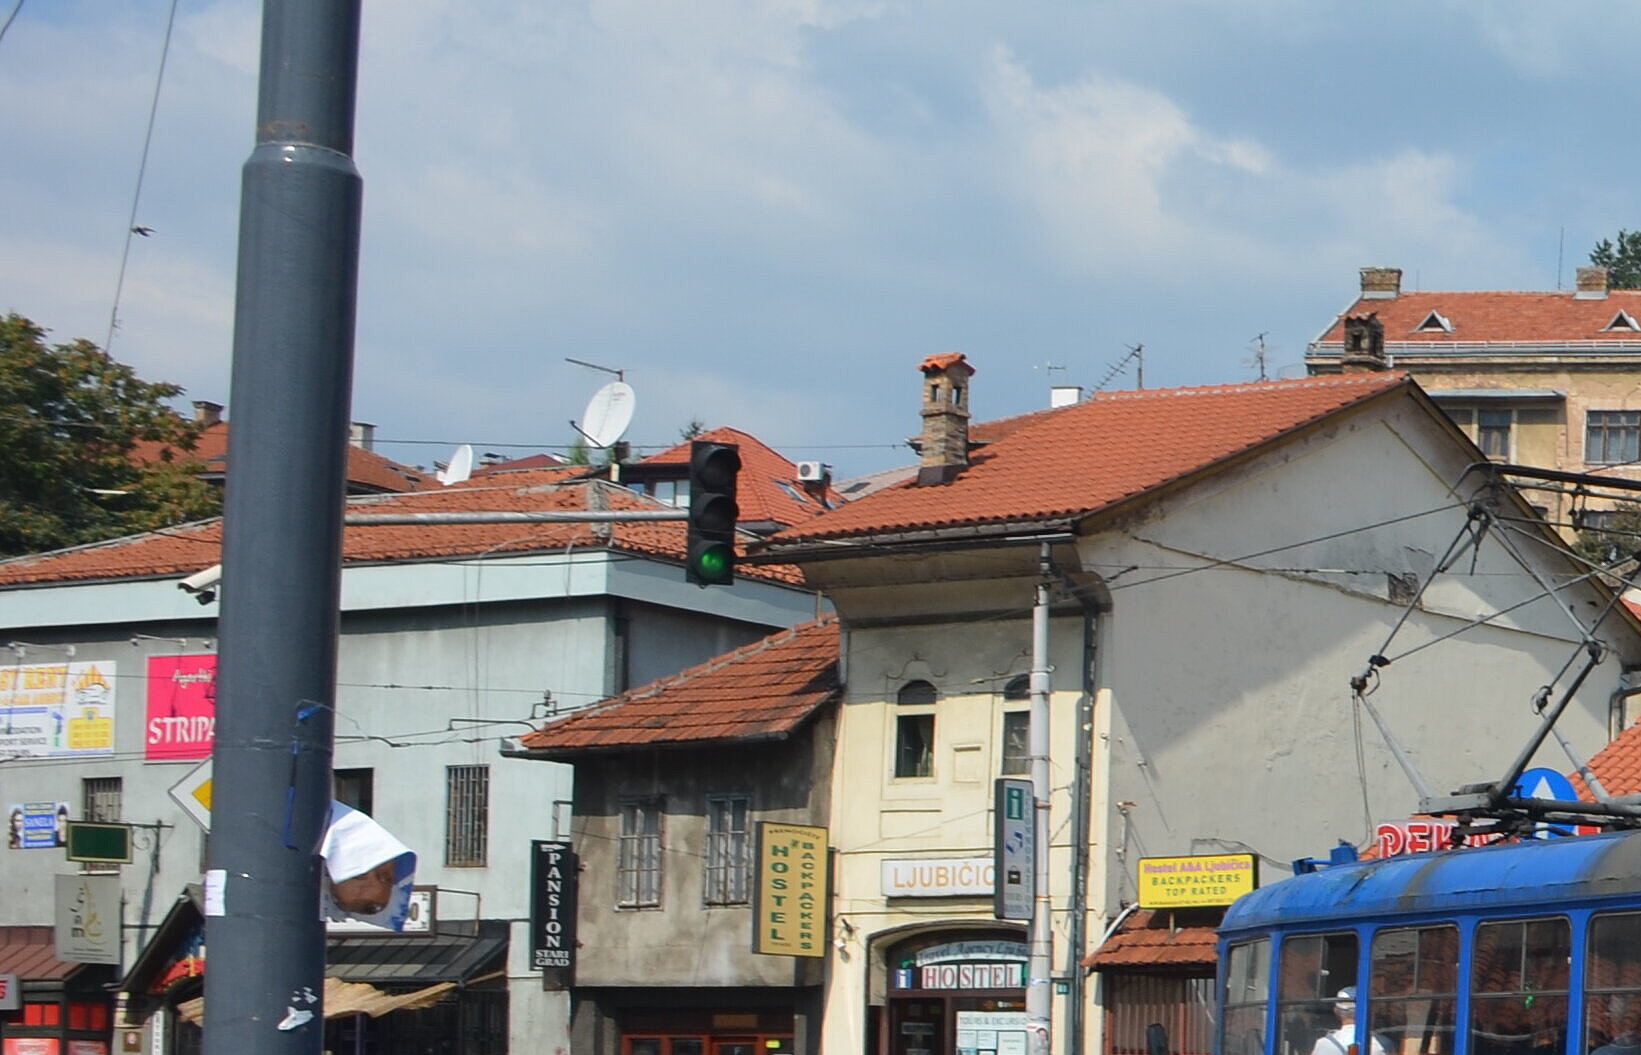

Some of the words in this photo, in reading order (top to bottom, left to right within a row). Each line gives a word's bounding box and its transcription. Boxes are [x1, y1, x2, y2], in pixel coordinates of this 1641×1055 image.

[1152, 874, 1241, 886] BACKPACKERS
[770, 844, 789, 941] HOSTEL
[799, 842, 815, 950] BACKPACKERS
[1166, 888, 1187, 897] TOP
[1192, 886, 1227, 896] RATED
[546, 853, 562, 948] PANSION
[535, 949, 569, 959] STARI
[535, 958, 570, 967] GRAD
[924, 967, 1019, 988] HOSTEL
